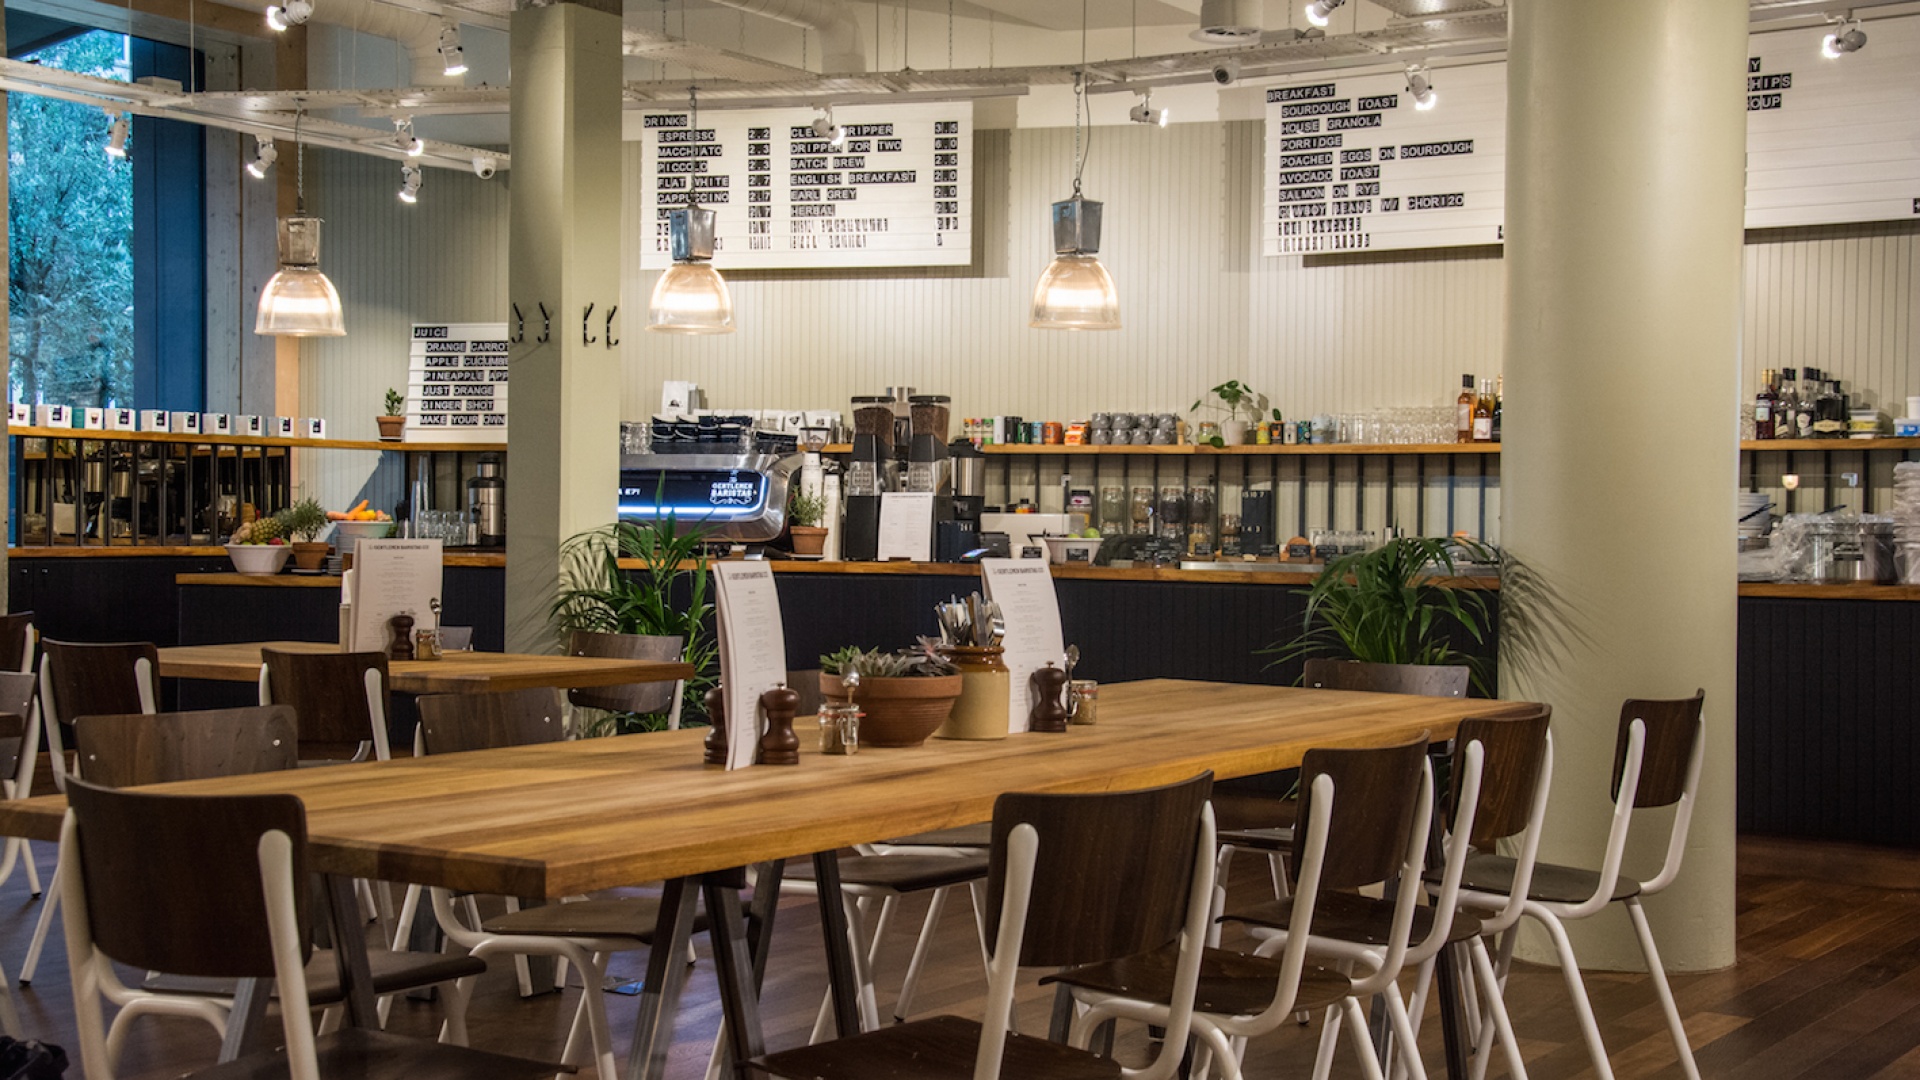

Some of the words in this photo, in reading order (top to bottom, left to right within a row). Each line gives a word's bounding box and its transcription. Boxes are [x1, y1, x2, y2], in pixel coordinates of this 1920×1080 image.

[1748, 75, 1791, 90] HIPS
[1267, 85, 1336, 102] BREAKFAST
[1282, 100, 1351, 118] SOURDOUGH
[1359, 96, 1397, 110] TOAST
[1748, 95, 1781, 109] OUP
[645, 116, 687, 127] DRINKS
[935, 122, 958, 135] 3.5
[1282, 120, 1320, 134] HOUSE
[1328, 115, 1381, 131] GRANOLA
[659, 131, 715, 142] ESPRESSO
[749, 128, 770, 140] 2.2
[791, 142, 842, 154] DRIPPER
[849, 141, 870, 152] FOR
[878, 140, 902, 152] TWO
[935, 138, 958, 150] 6.0
[1281, 135, 1342, 151] PORRIDGE
[658, 146, 722, 158] MACCHIATO
[749, 144, 770, 155] 2.3
[1281, 153, 1333, 168] POACHED
[1341, 149, 1371, 164] EGGS
[1379, 147, 1395, 159] ON
[1401, 141, 1473, 159] SOURDOUGH
[658, 161, 707, 173] PICCOLO
[749, 159, 770, 171] 2.3
[791, 158, 827, 170] BATCH
[834, 157, 865, 169] BREW
[935, 154, 958, 167] 2.5
[658, 177, 686, 189] FLAT
[693, 176, 729, 187] WHITE
[749, 175, 770, 186] 2.7
[791, 173, 842, 185] ENGLISH
[850, 171, 916, 184] BREAKFAST
[935, 170, 957, 182] 2.0
[1280, 170, 1333, 185] AVOCADO
[1341, 166, 1380, 180] TOAST
[658, 191, 729, 203] CAPPUCCINO
[749, 191, 770, 202] 2.7
[791, 189, 820, 201] EARL
[828, 188, 857, 200] GREY
[935, 186, 957, 198] 2.0
[1279, 188, 1325, 202] SALMON
[1333, 186, 1348, 198] ON
[1356, 184, 1380, 196] RYE
[791, 205, 835, 216] HERBAL
[415, 327, 447, 337] JUICE
[427, 342, 466, 352] ORANGE
[426, 356, 458, 366] APPLE
[424, 371, 484, 381] PINEAPPLE
[423, 386, 450, 396] JUST
[454, 386, 493, 396] ORANGE
[421, 400, 461, 410] GINGER
[466, 400, 493, 410] SHOT
[420, 415, 447, 425] MAKE
[451, 415, 478, 425] YOUR
[483, 415, 505, 425] OWN
[711, 489, 752, 497] BARISTAS
